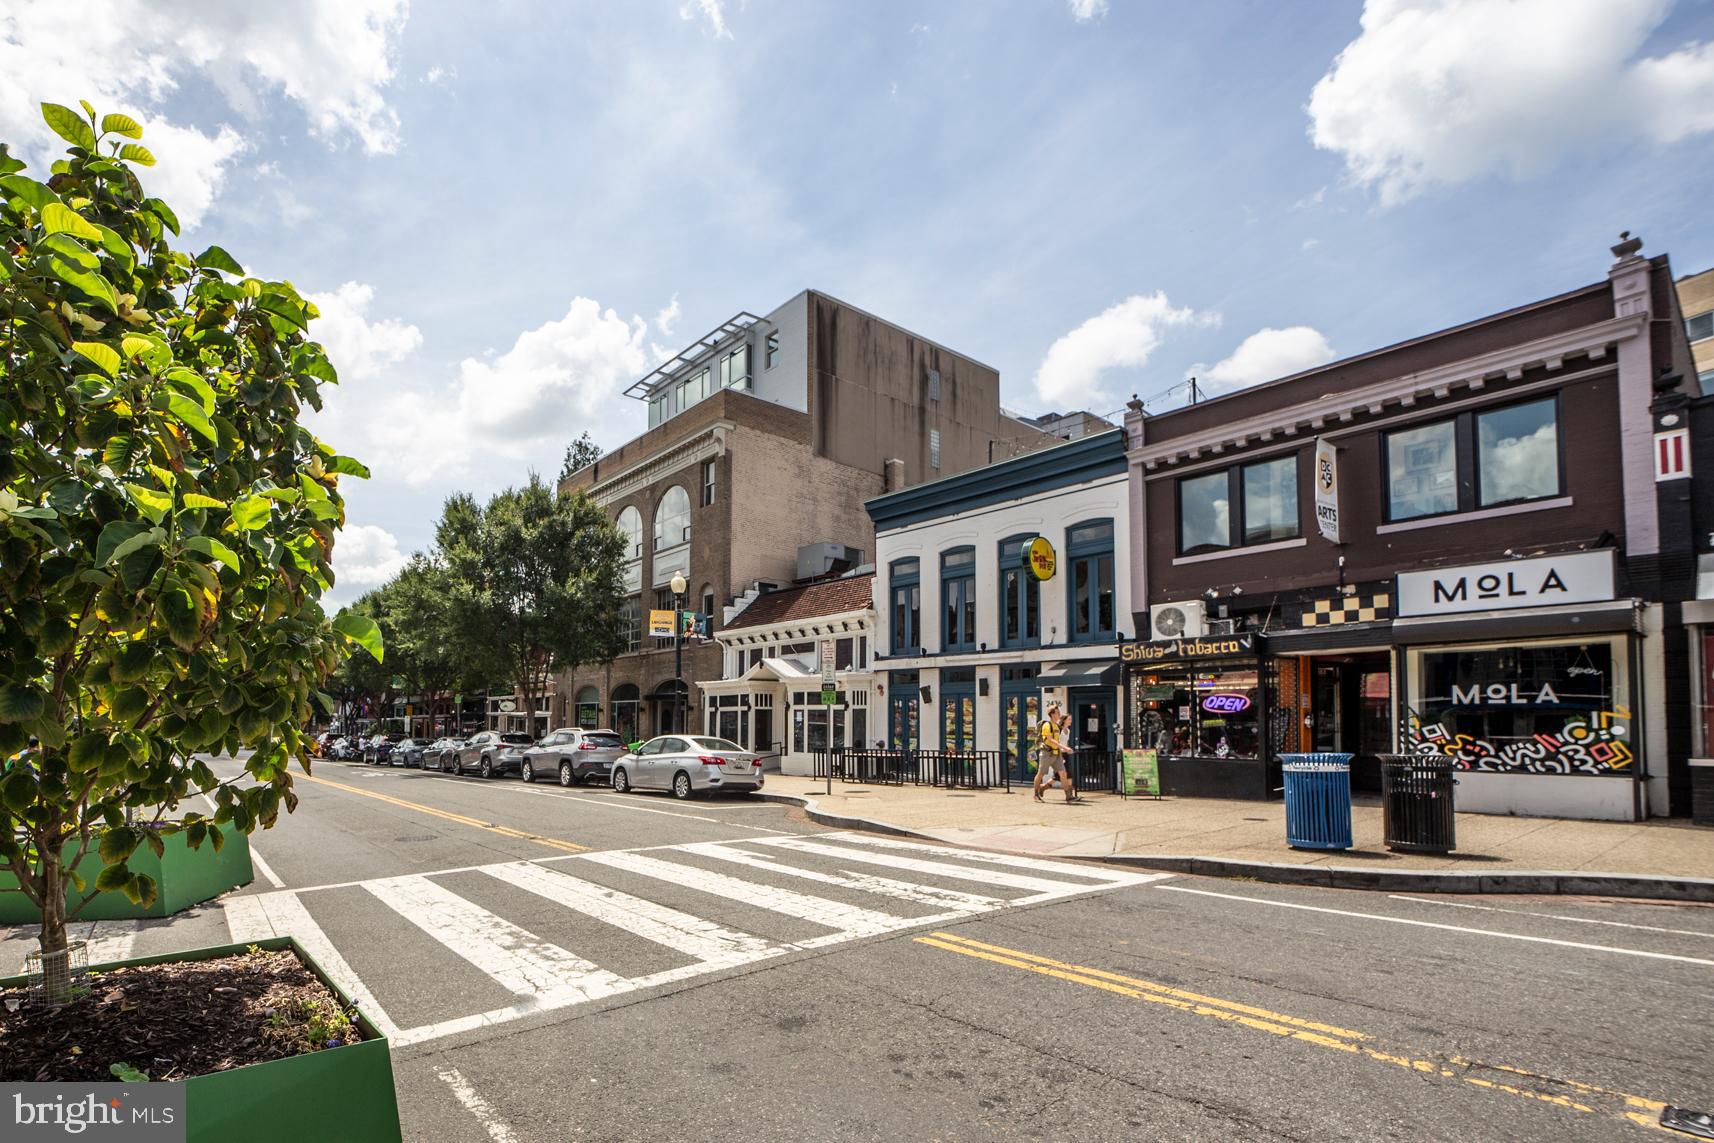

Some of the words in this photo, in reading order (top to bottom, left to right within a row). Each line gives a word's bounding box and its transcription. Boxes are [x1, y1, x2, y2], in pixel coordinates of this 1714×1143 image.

[1318, 505, 1337, 522] ARTS
[1122, 643, 1164, 660] Shiva
[1177, 638, 1239, 657] tobacco
[1205, 696, 1245, 711] OPEN
